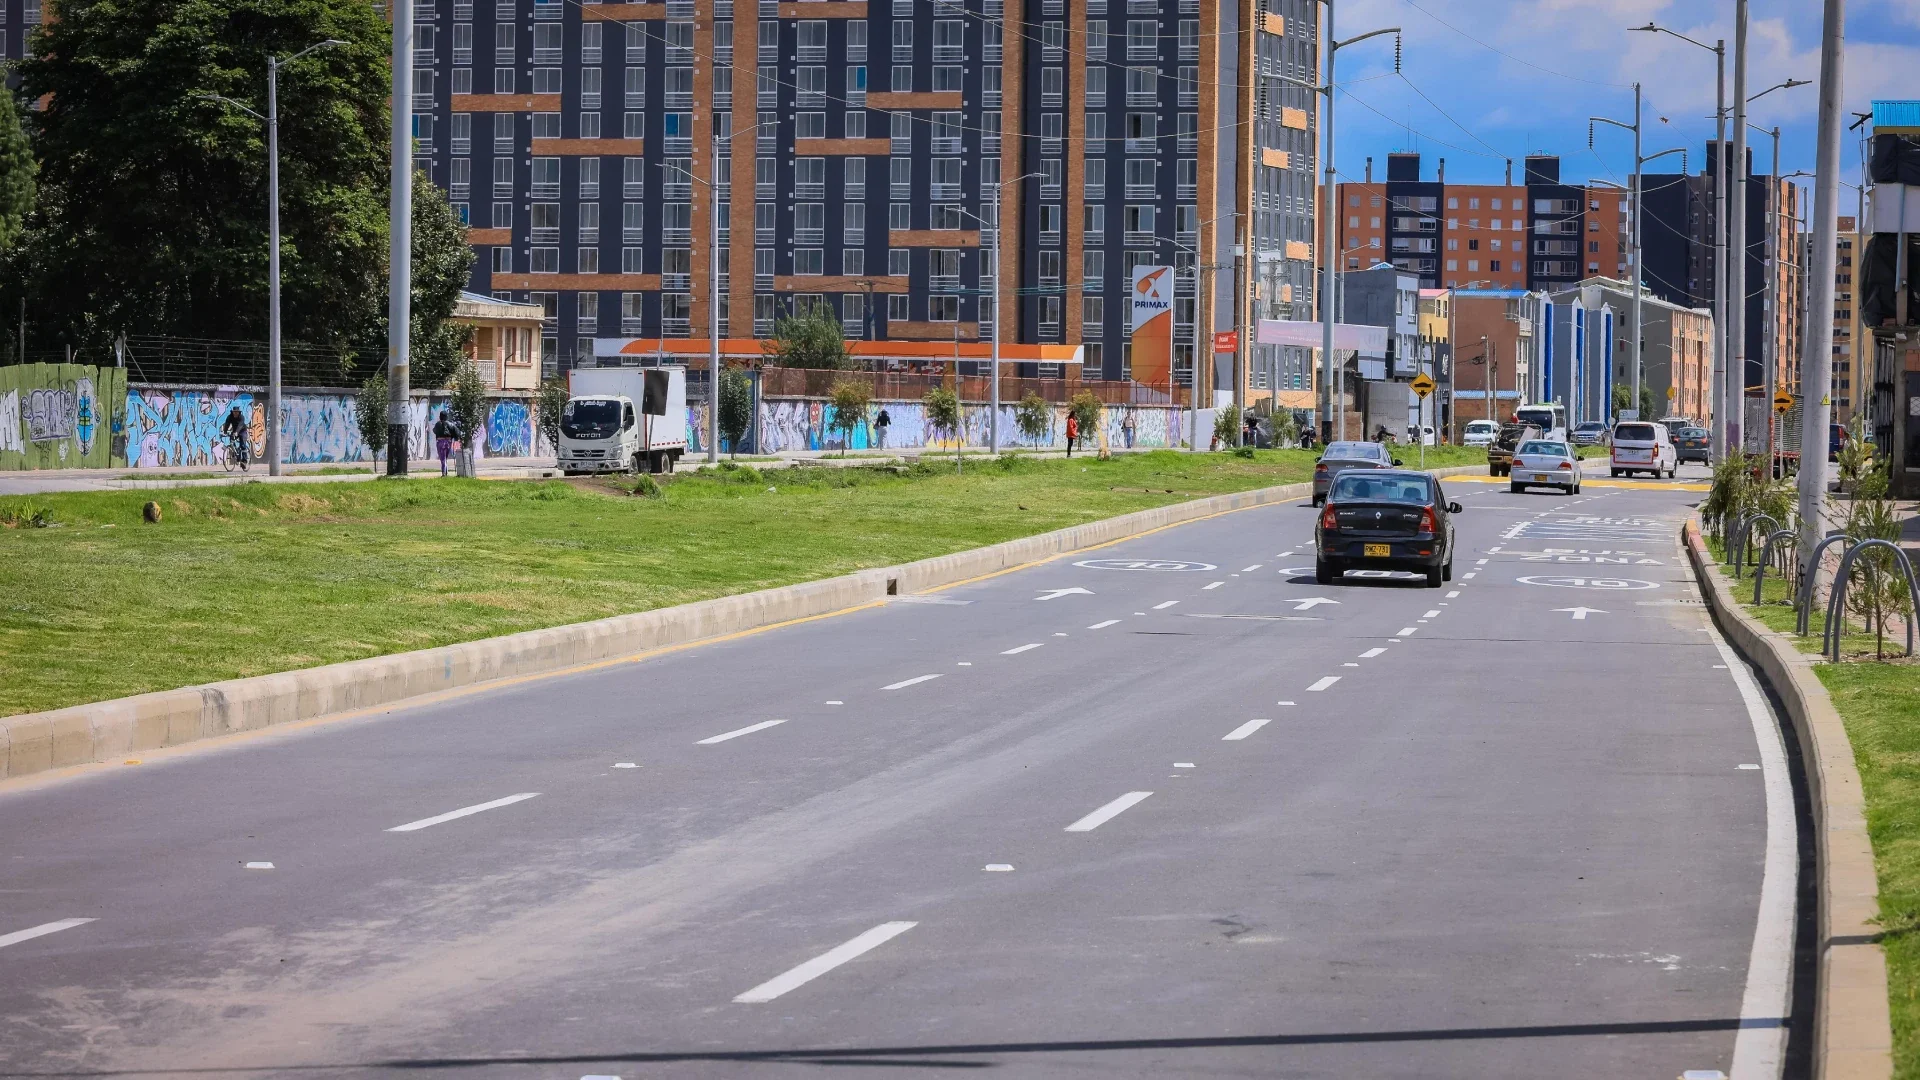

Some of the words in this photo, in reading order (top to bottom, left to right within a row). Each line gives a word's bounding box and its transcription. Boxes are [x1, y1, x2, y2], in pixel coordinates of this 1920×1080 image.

[1519, 554, 1665, 565] ZONA
[1105, 562, 1188, 570] 40
[1548, 578, 1629, 587] 40
